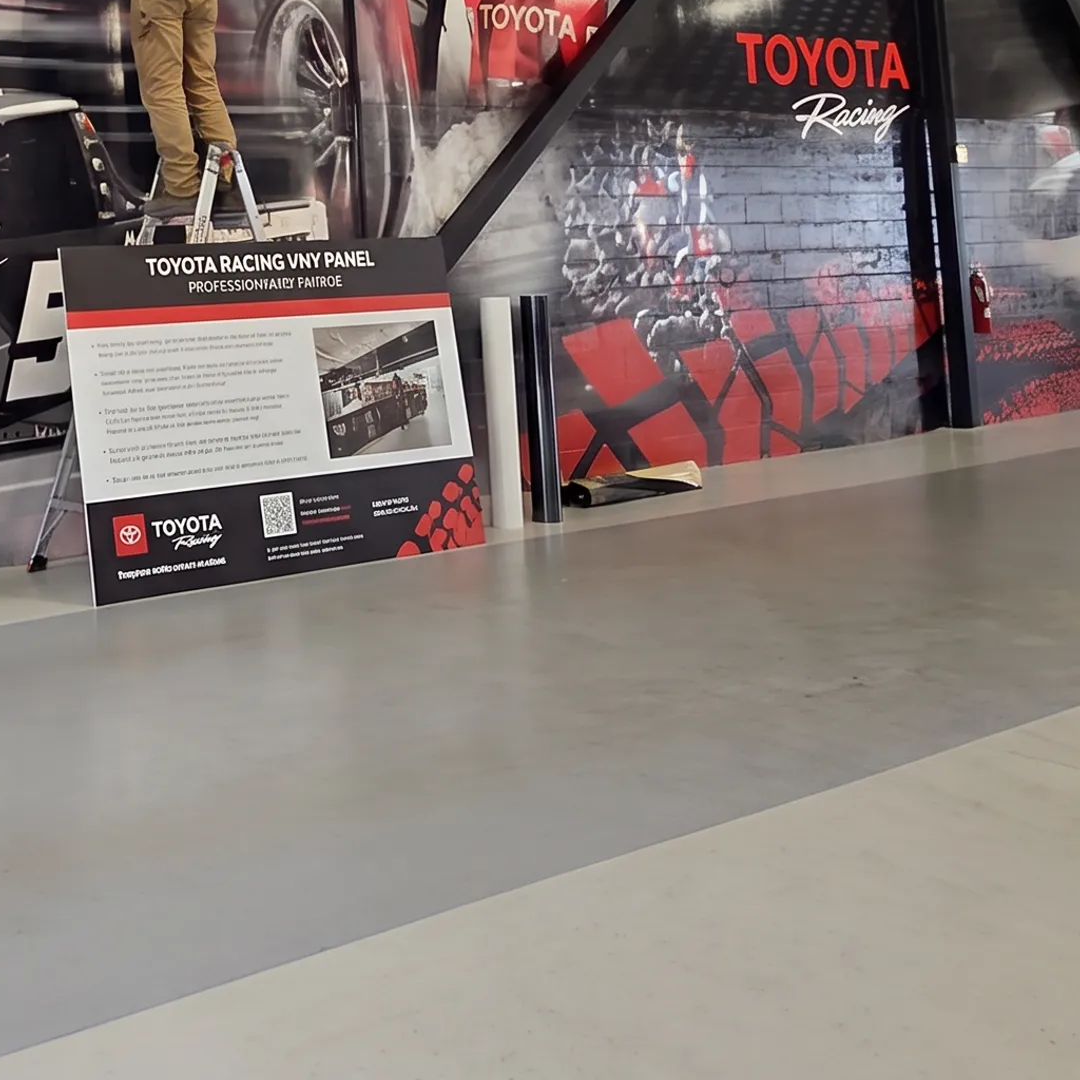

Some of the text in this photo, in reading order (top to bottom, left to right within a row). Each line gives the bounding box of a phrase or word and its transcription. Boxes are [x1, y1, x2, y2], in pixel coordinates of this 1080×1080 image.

[479, 3, 577, 43] TOYOTA
[736, 32, 910, 89] TOYOTA
[792, 93, 910, 143] Racing
[145, 250, 375, 276] TOYOTA RACING VNY PANEL
[151, 514, 222, 537] TOYOTA
